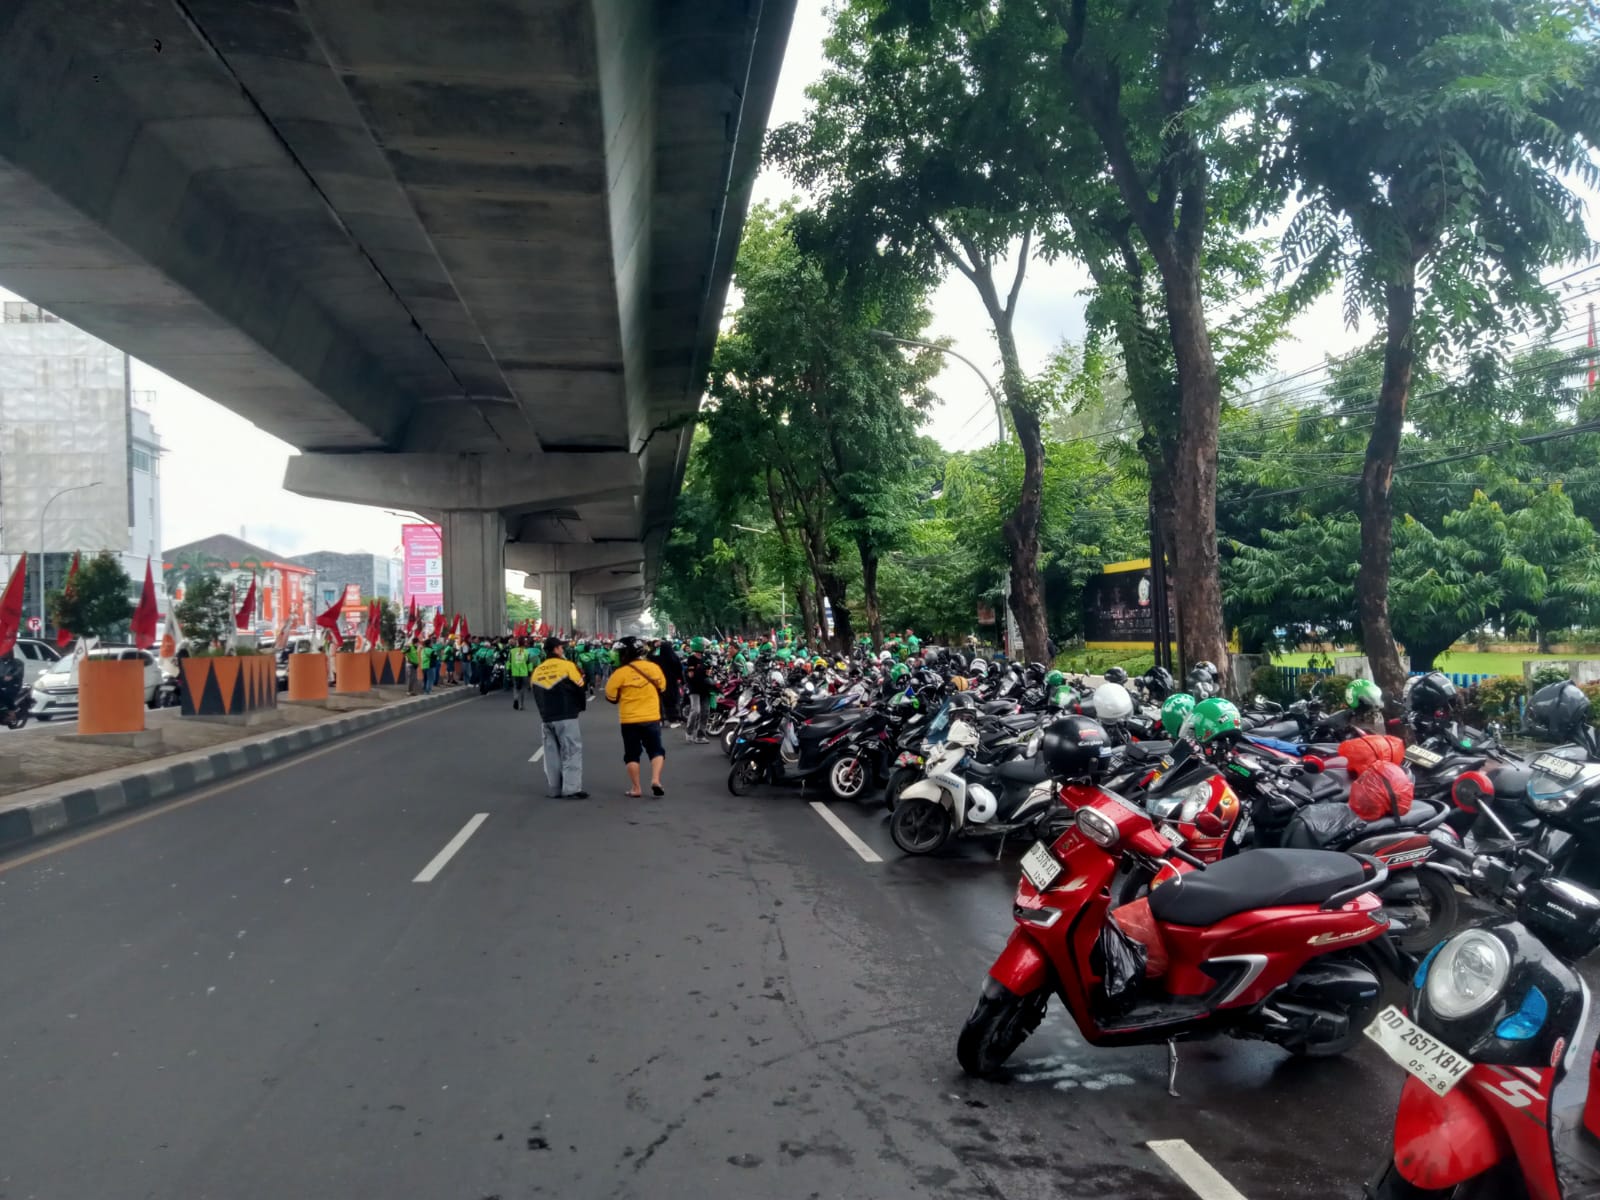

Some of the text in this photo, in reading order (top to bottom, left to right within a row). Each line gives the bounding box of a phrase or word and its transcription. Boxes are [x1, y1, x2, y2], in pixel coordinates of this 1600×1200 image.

[1546, 901, 1577, 920] HONDA
[1381, 1009, 1468, 1078] DD 2657 XBW
